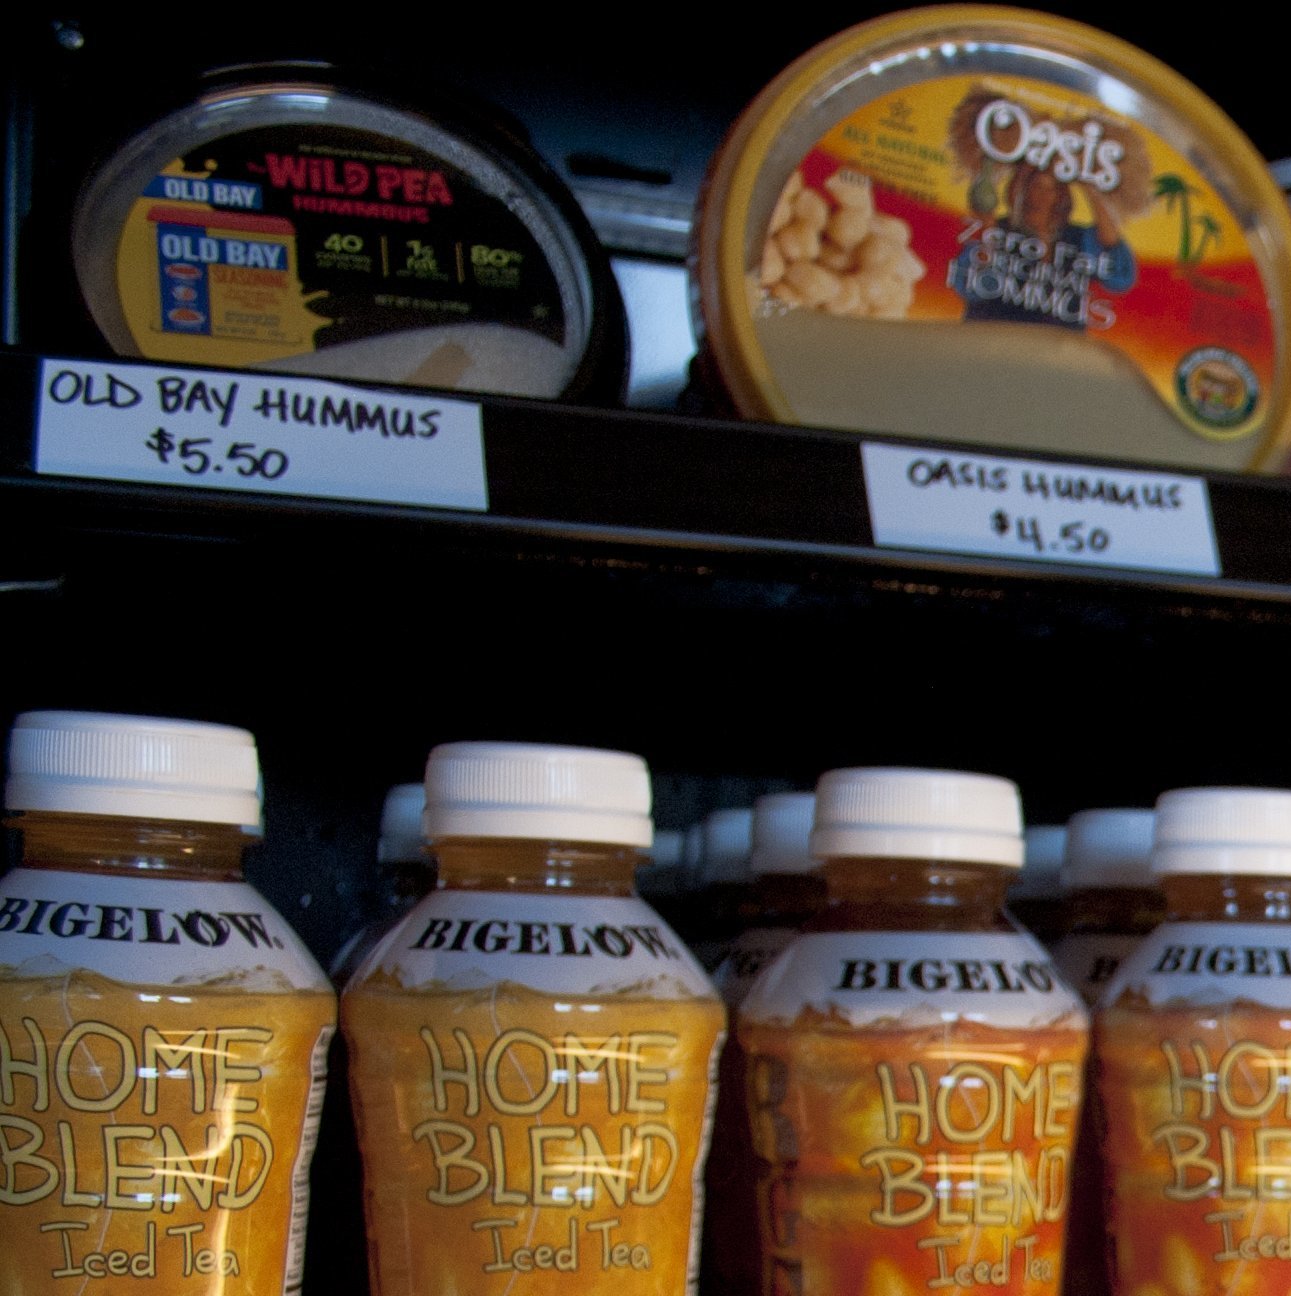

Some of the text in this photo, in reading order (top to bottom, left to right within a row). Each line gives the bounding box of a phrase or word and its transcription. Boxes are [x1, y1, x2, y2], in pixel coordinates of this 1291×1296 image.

[975, 100, 1124, 192] Oasis
[164, 179, 257, 207] OLD BAY
[265, 153, 370, 196] WILD
[375, 164, 453, 206] PEA
[161, 234, 219, 263] OLD
[226, 240, 281, 268] BAY
[49, 371, 441, 439] OLD BAY HUMMUS
[146, 428, 289, 478] $5.50
[908, 457, 1183, 509] OASIS HUMMUS
[991, 508, 1111, 552] $4.50
[0, 896, 273, 949] BIGELOW
[409, 917, 672, 958] BIGELOW
[833, 958, 1057, 994] BIGELO
[0, 1017, 273, 1115] HOME
[420, 1026, 679, 1116] HOME
[875, 1060, 1077, 1145] HOME
[0, 1115, 273, 1210] BLEND
[413, 1119, 679, 1210] BLEND
[858, 1147, 1069, 1228] BLEND
[40, 1222, 239, 1278] Iced Tea
[473, 1219, 653, 1273] Iced Tea
[917, 1236, 1055, 1289] Iced Tea
